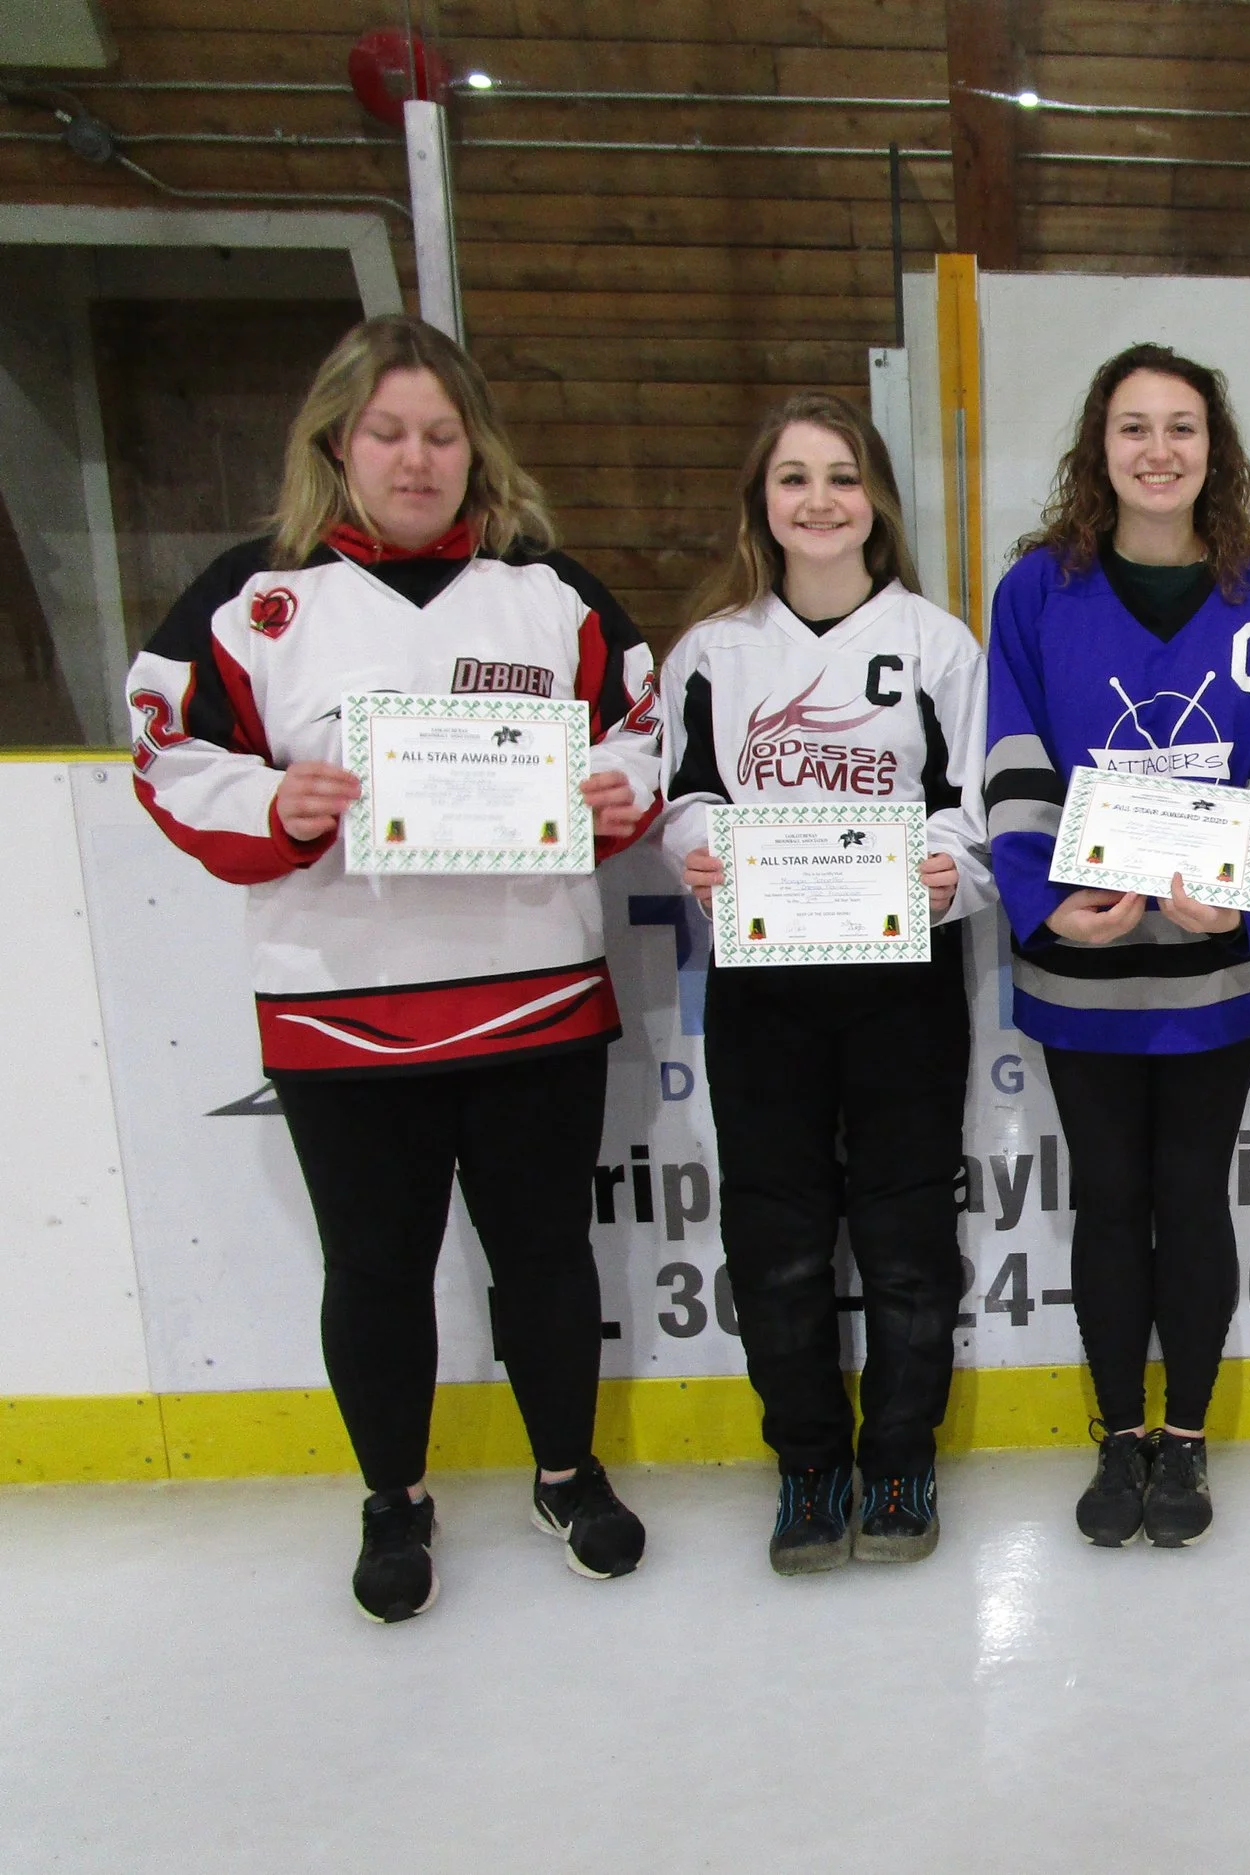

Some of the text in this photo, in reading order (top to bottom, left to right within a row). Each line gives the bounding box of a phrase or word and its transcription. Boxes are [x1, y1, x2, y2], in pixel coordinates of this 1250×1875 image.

[451, 658, 554, 697] DEBDEN
[865, 654, 904, 707] C
[401, 751, 540, 766] ALL STAR AWARD 2020
[752, 739, 898, 766] ODESSA
[1107, 752, 1224, 775] ATTACERS
[754, 756, 897, 796] FLAMES
[1112, 803, 1229, 825] ALL STAR AWARD 2020
[760, 854, 882, 866] ALL STAR AWARD 2020
[594, 1145, 711, 1241] rip
